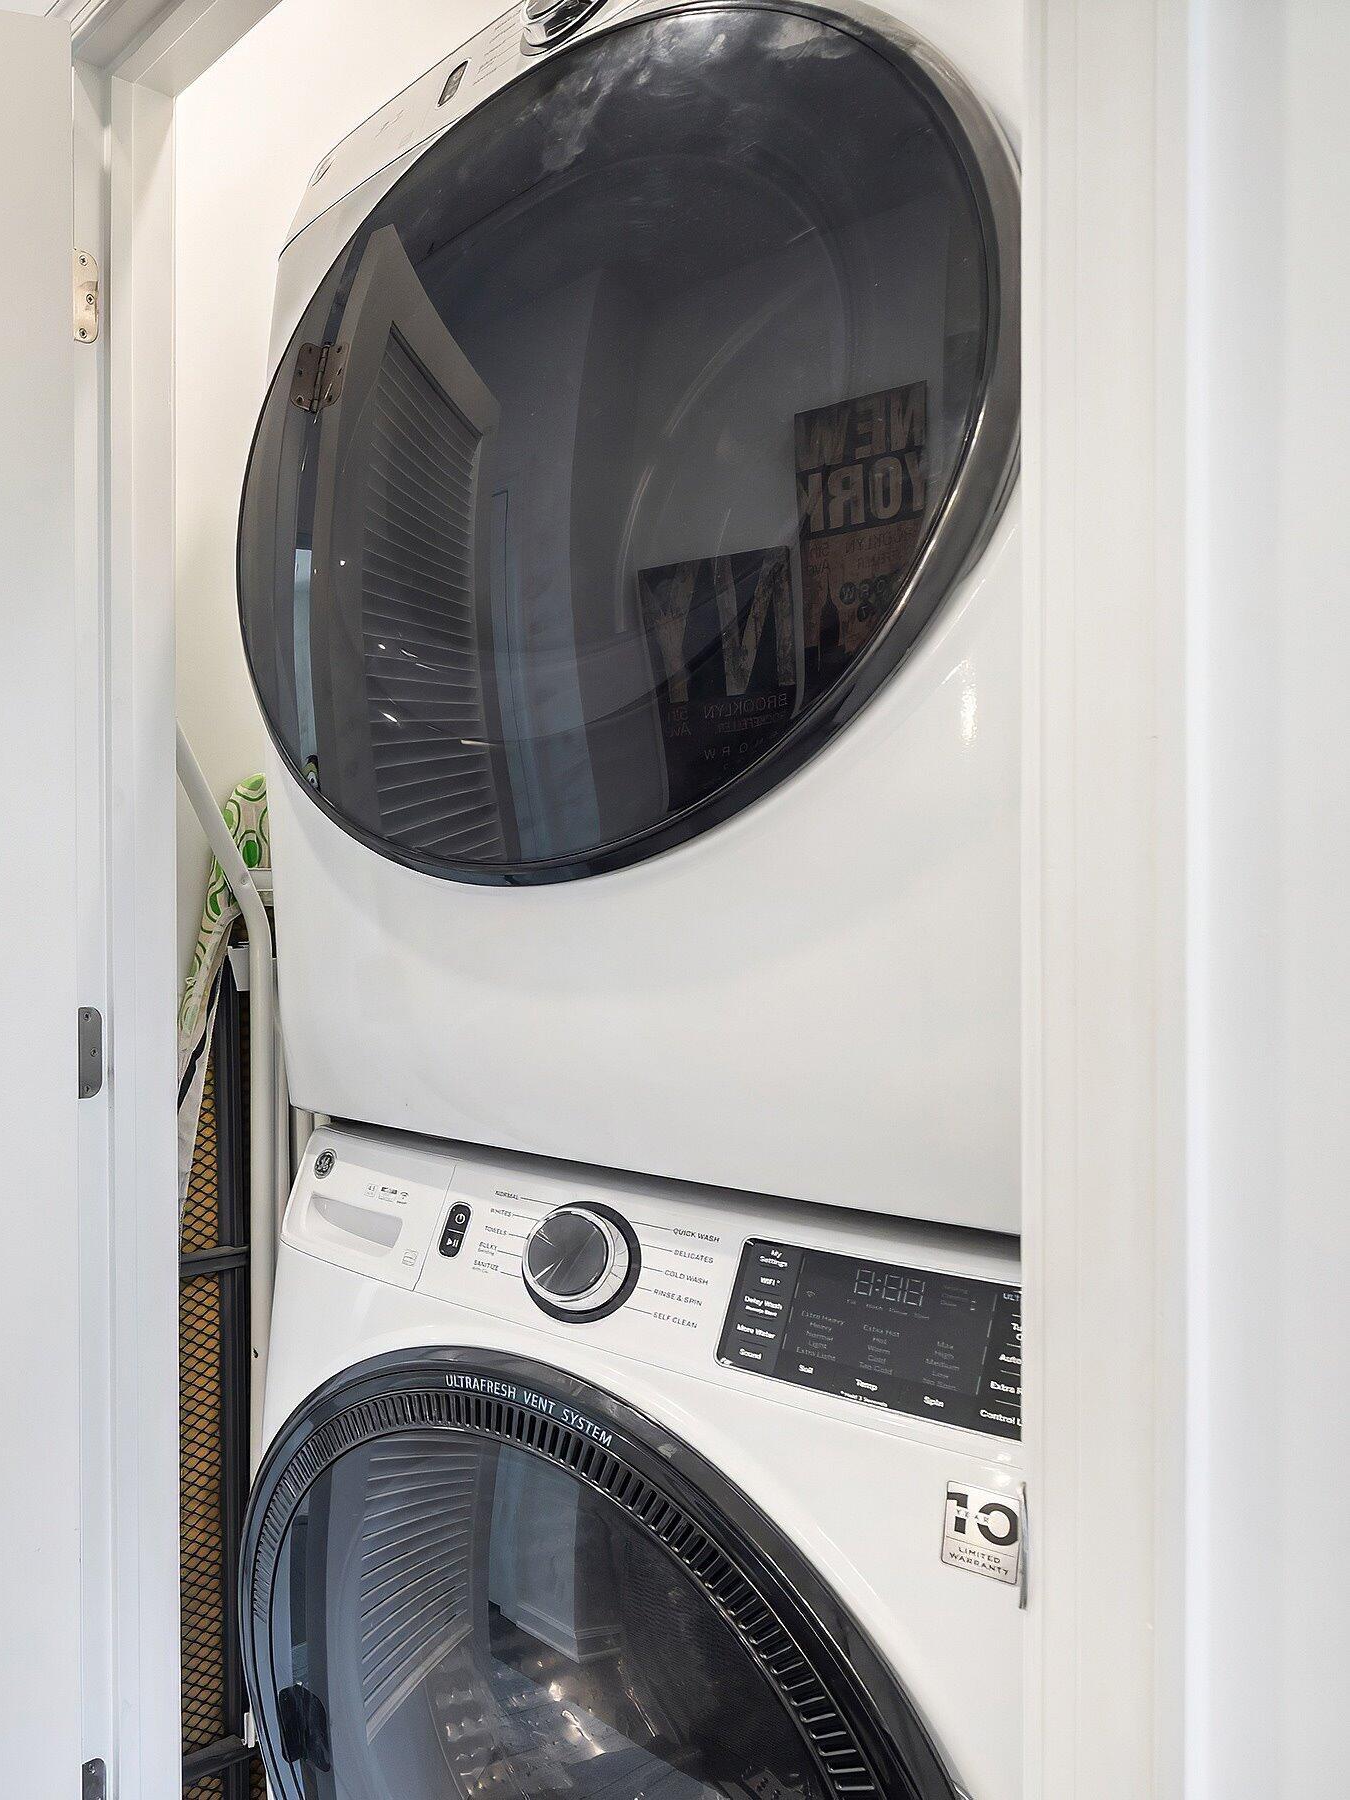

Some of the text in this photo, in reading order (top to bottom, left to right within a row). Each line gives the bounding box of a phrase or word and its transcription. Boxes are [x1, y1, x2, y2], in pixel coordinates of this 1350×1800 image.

[494, 1190, 519, 1200] NORMAL
[490, 1208, 512, 1218] WHITES
[484, 1225, 508, 1236] TOWELS
[672, 1228, 720, 1243] QUICK WASH
[674, 1249, 714, 1264] DELICATES
[770, 1249, 782, 1259] My
[474, 1260, 499, 1272] SANITIZE
[759, 1256, 788, 1268] Settings
[664, 1269, 709, 1286] COLD WASH
[654, 1288, 702, 1306] RINSE & SPIN
[744, 1295, 783, 1310] Delay Wash
[653, 1311, 698, 1329] SELF CLEAN
[736, 1323, 776, 1340] More Water
[738, 1348, 762, 1361] Sound
[798, 1364, 814, 1374] Soil
[854, 1378, 879, 1392] Temp
[990, 1380, 1016, 1394] Extra
[923, 1395, 944, 1408] Spin
[445, 1374, 613, 1447] ULTRAFRESH VENT SYSTEM
[980, 1409, 1016, 1425] Control
[947, 1492, 1018, 1546] 10
[958, 1546, 1001, 1564] LIMITED
[949, 1552, 1009, 1576] WARRANTY
